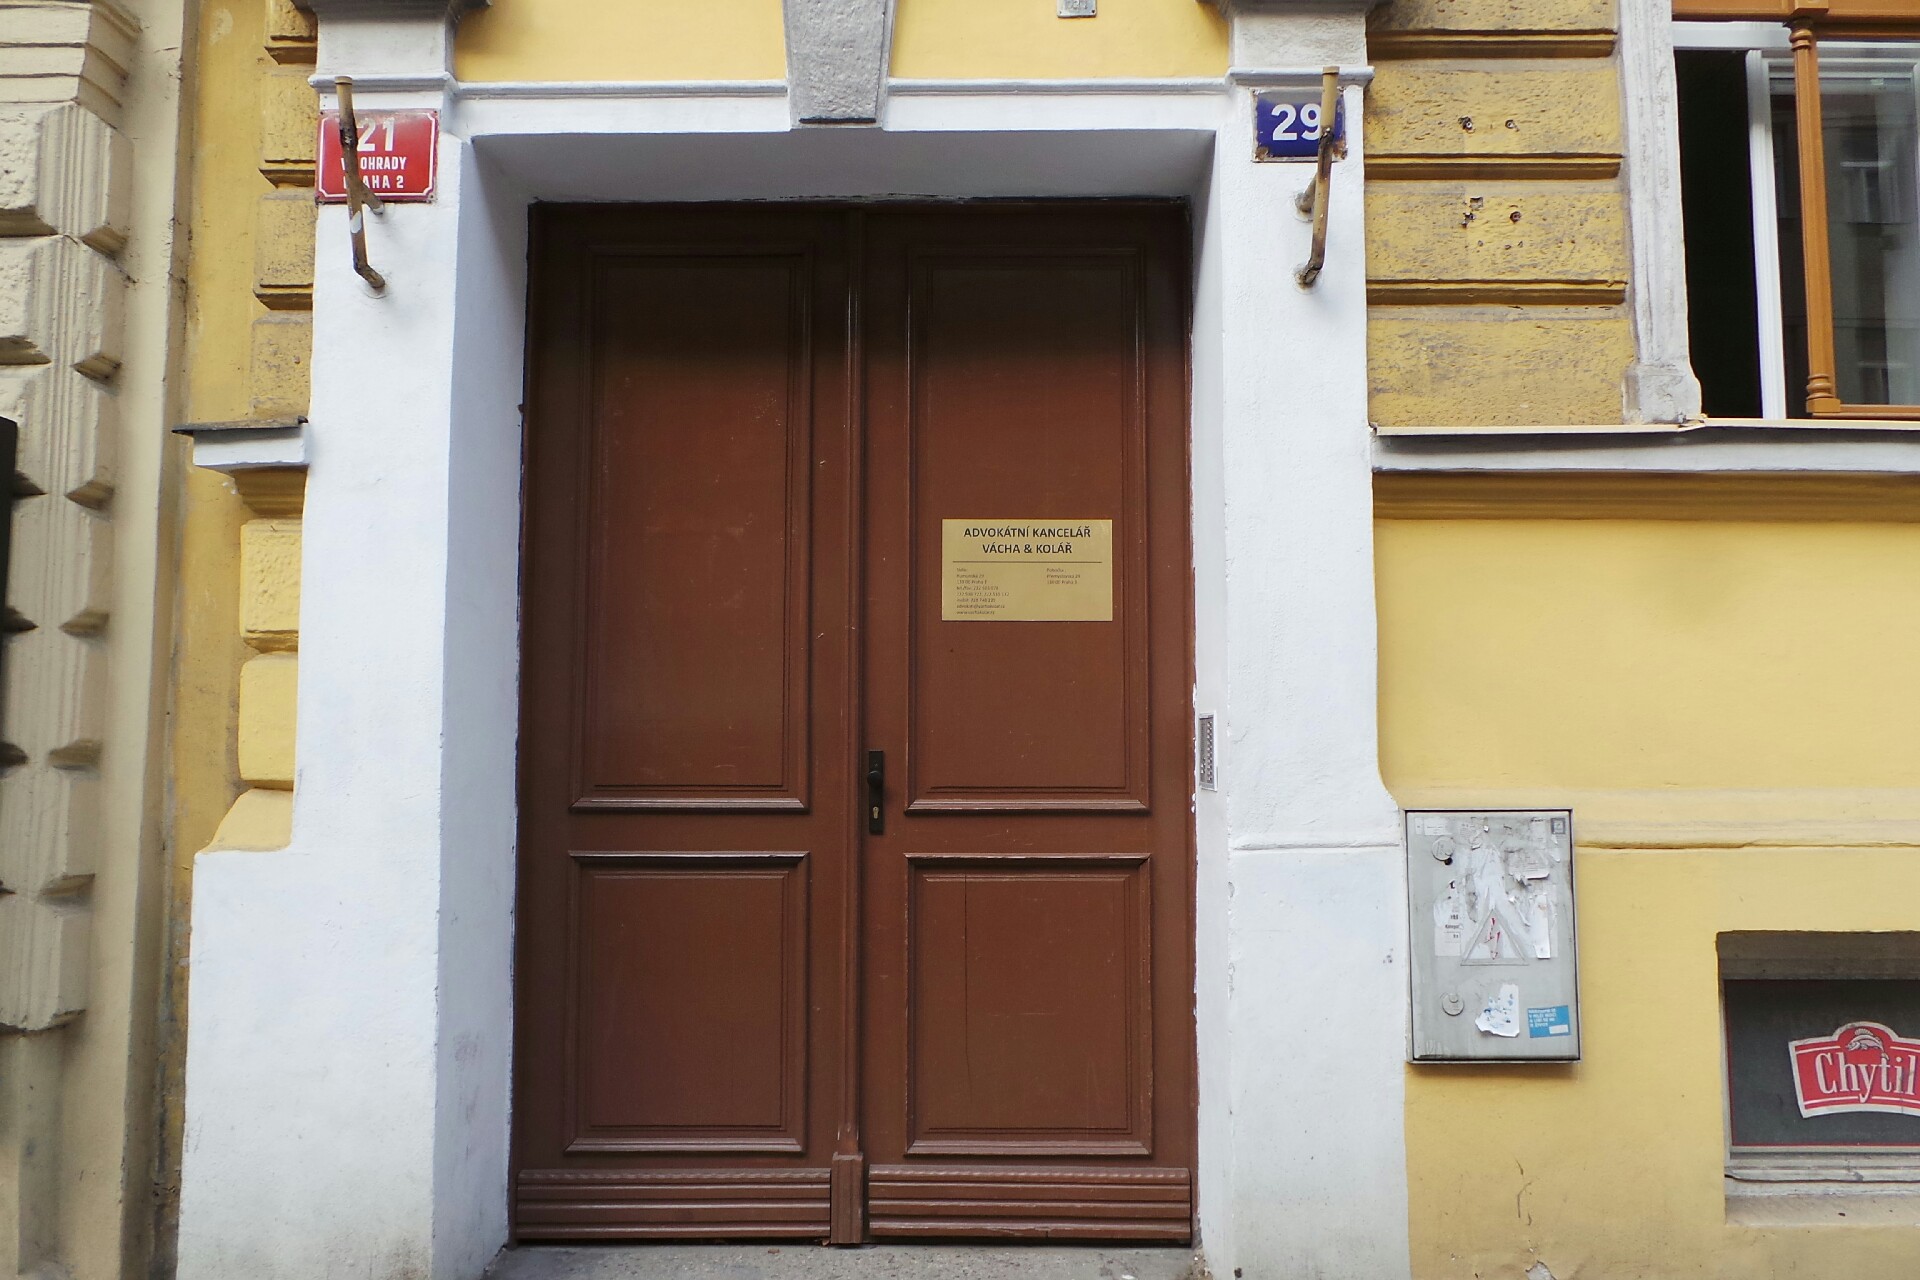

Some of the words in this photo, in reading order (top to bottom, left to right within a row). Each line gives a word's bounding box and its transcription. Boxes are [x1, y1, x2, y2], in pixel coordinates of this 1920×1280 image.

[1271, 103, 1321, 141] 29
[356, 117, 396, 152] 21
[343, 175, 391, 189] AHA
[396, 175, 404, 189] 2
[963, 525, 1030, 538] ADVOKÁTNÍ
[1032, 525, 1091, 538] KANCELÁŘ
[982, 541, 1021, 554] VÁCHA
[1023, 544, 1033, 554] &
[1036, 541, 1073, 554] KOLÁŘ
[1815, 1052, 1916, 1104] Chytil
